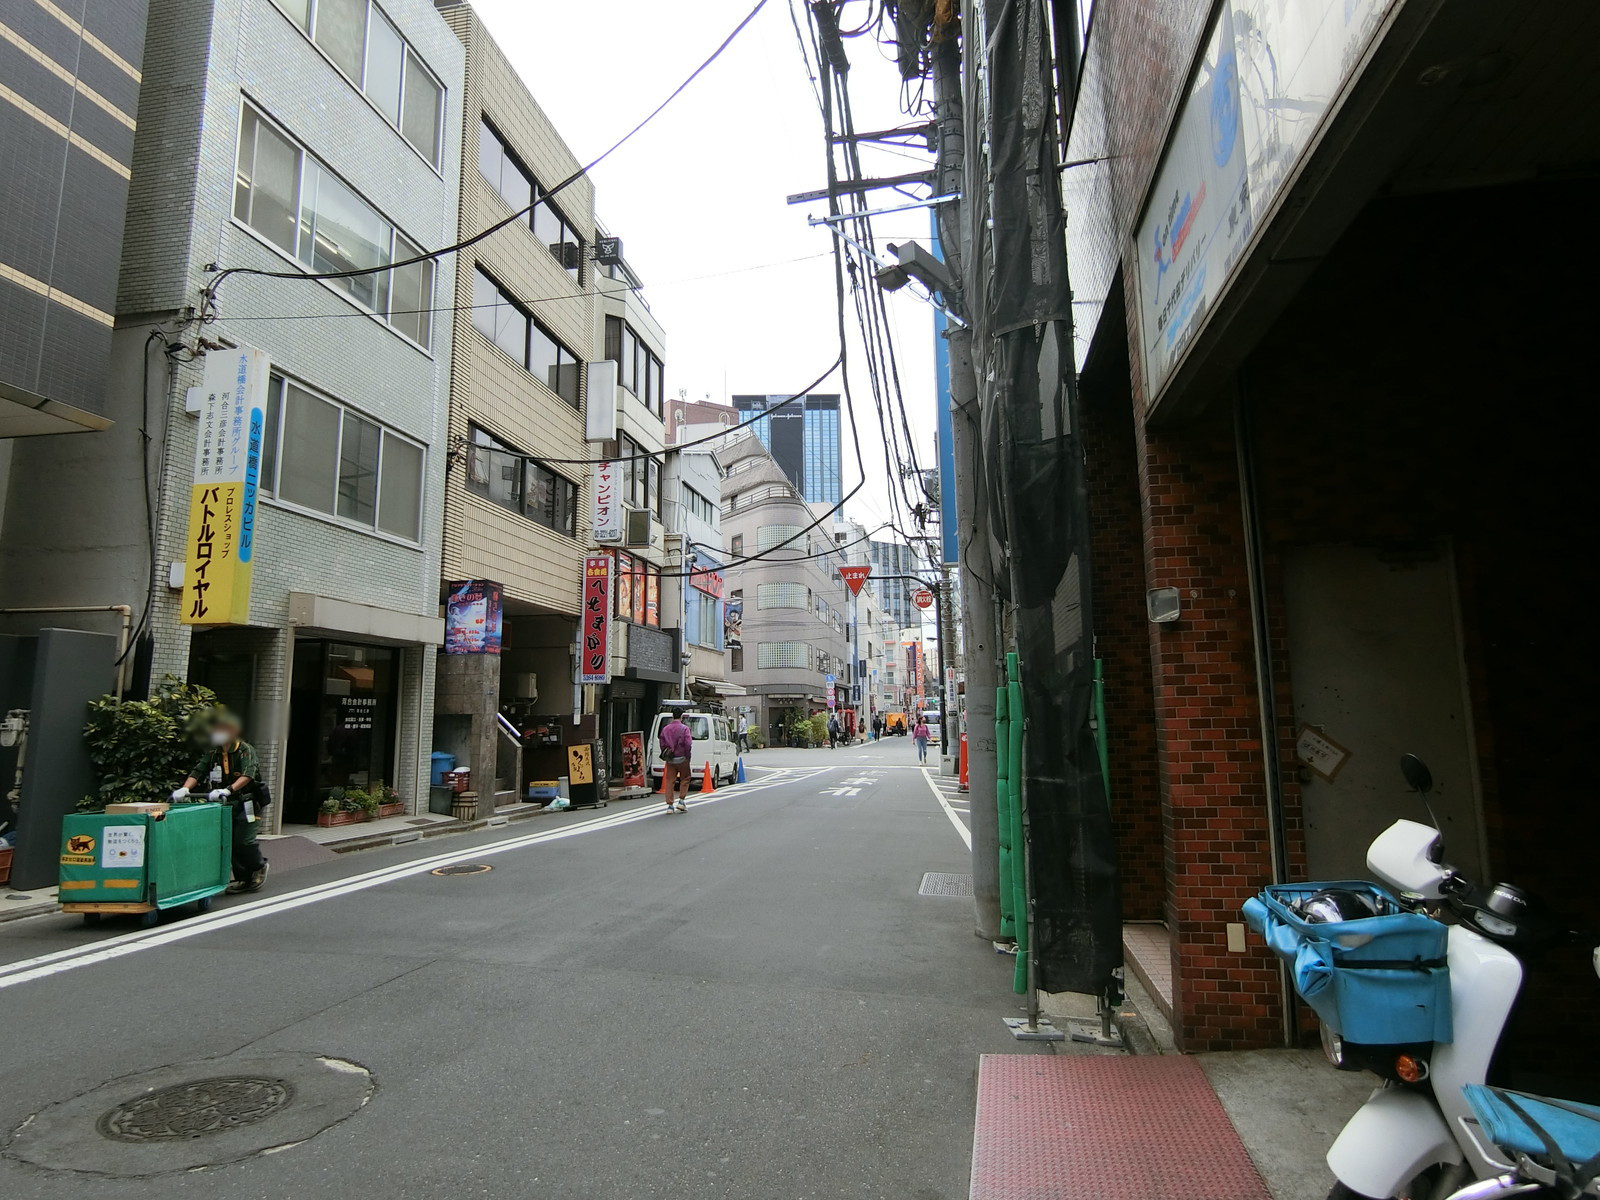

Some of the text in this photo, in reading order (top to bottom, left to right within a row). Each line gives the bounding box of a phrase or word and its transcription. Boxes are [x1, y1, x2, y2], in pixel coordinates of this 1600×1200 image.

[200, 393, 216, 476] 森下志文会計事務所
[228, 353, 248, 476] 水道橋会計事務所グループ
[221, 488, 236, 559] プロレスショップ
[240, 420, 262, 549] 水道橋ニッカビル
[597, 462, 611, 527] チャンピオン
[190, 486, 220, 619] バトルロイヤル
[845, 572, 866, 580] 止まれ
[586, 579, 606, 670] へそまがり
[1493, 889, 1528, 906] HONDA
